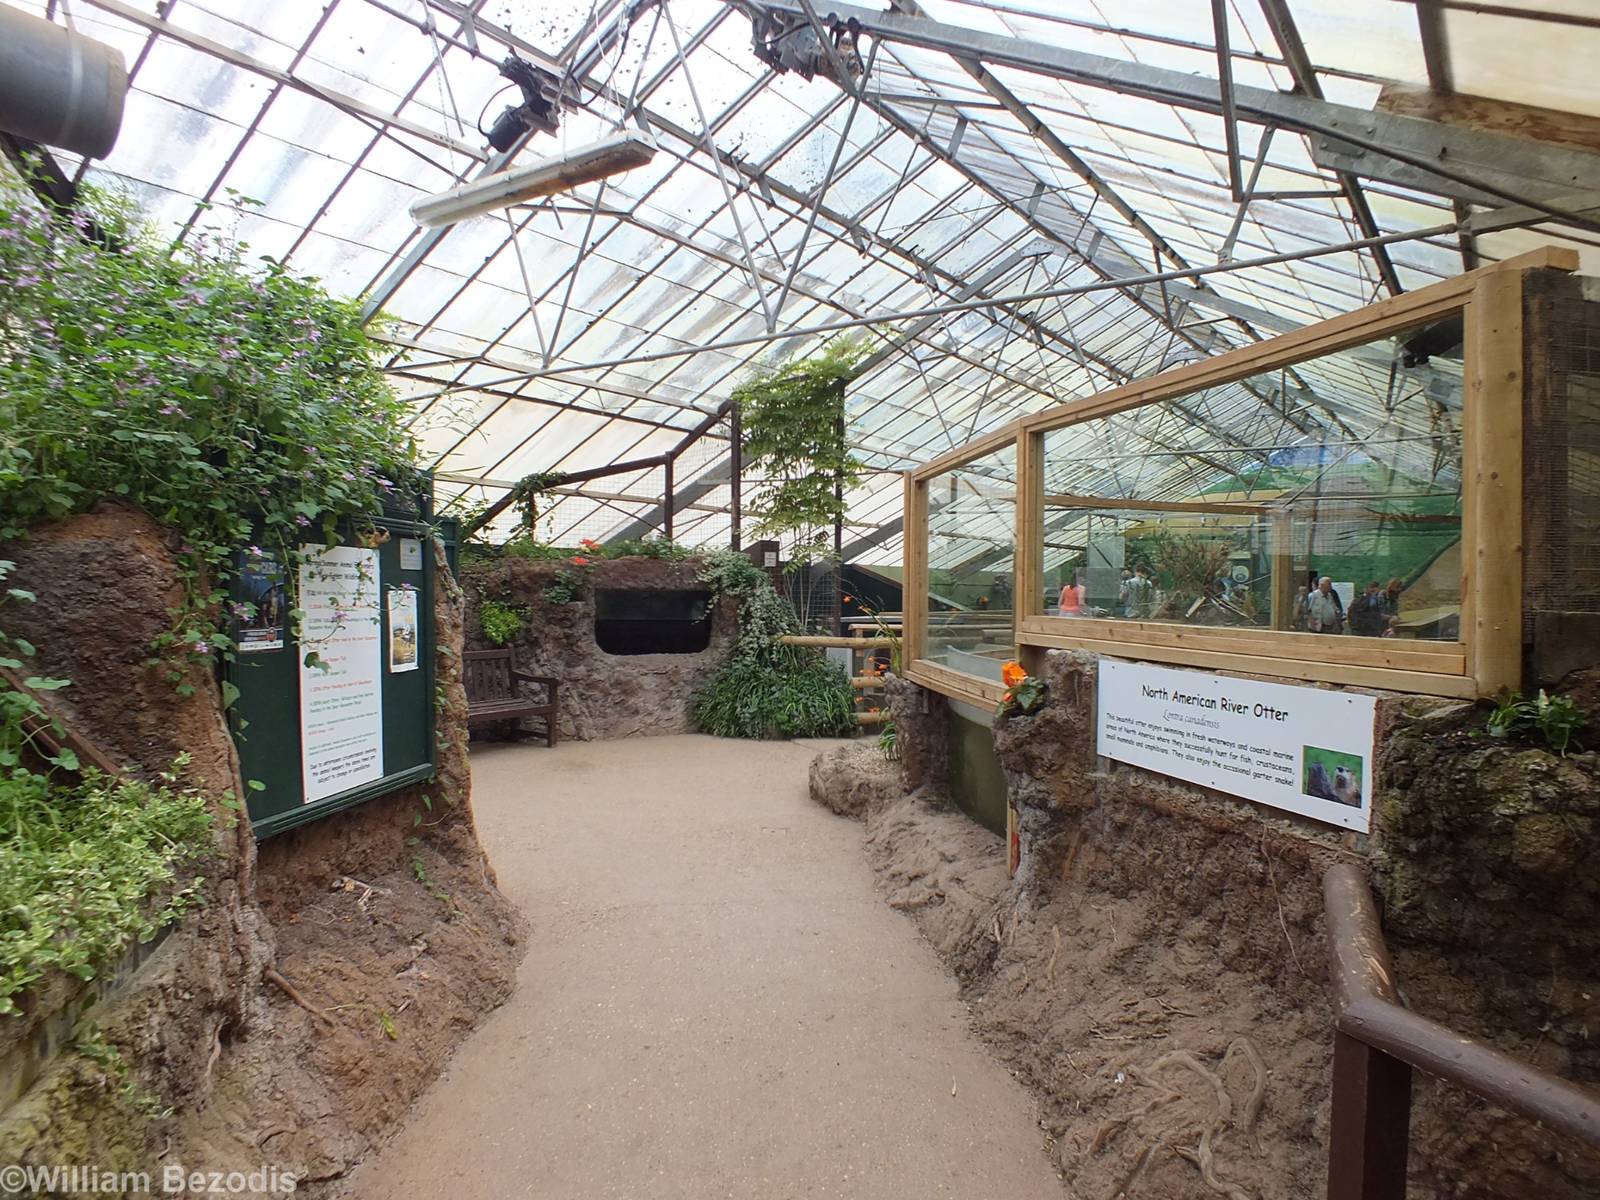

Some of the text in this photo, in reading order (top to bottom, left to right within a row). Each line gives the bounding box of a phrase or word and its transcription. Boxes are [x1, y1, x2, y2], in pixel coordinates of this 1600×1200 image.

[1142, 685, 1288, 722] North American River Otter
[1116, 715, 1134, 725] beautiful
[1148, 722, 1162, 731] enjoys
[1164, 726, 1185, 738] swimming
[1192, 732, 1206, 742] fresh
[1208, 737, 1236, 748] waterways
[1249, 746, 1271, 756] coastal
[1273, 751, 1294, 761] marine
[1117, 736, 1135, 746] mammals
[1172, 749, 1184, 760] They
[1196, 756, 1210, 766] enjoy
[1223, 763, 1251, 775] occasional
[1252, 770, 1272, 780] garter
[1274, 777, 1294, 786] snake!
[1124, 727, 1136, 735] North
[1138, 731, 1156, 740] America
[1157, 735, 1170, 744] where
[1172, 739, 1182, 748] they
[1184, 743, 1213, 756] successfully
[1229, 751, 1238, 760] for
[1240, 754, 1253, 765] fish,
[1256, 759, 1295, 775] crustaceans,
